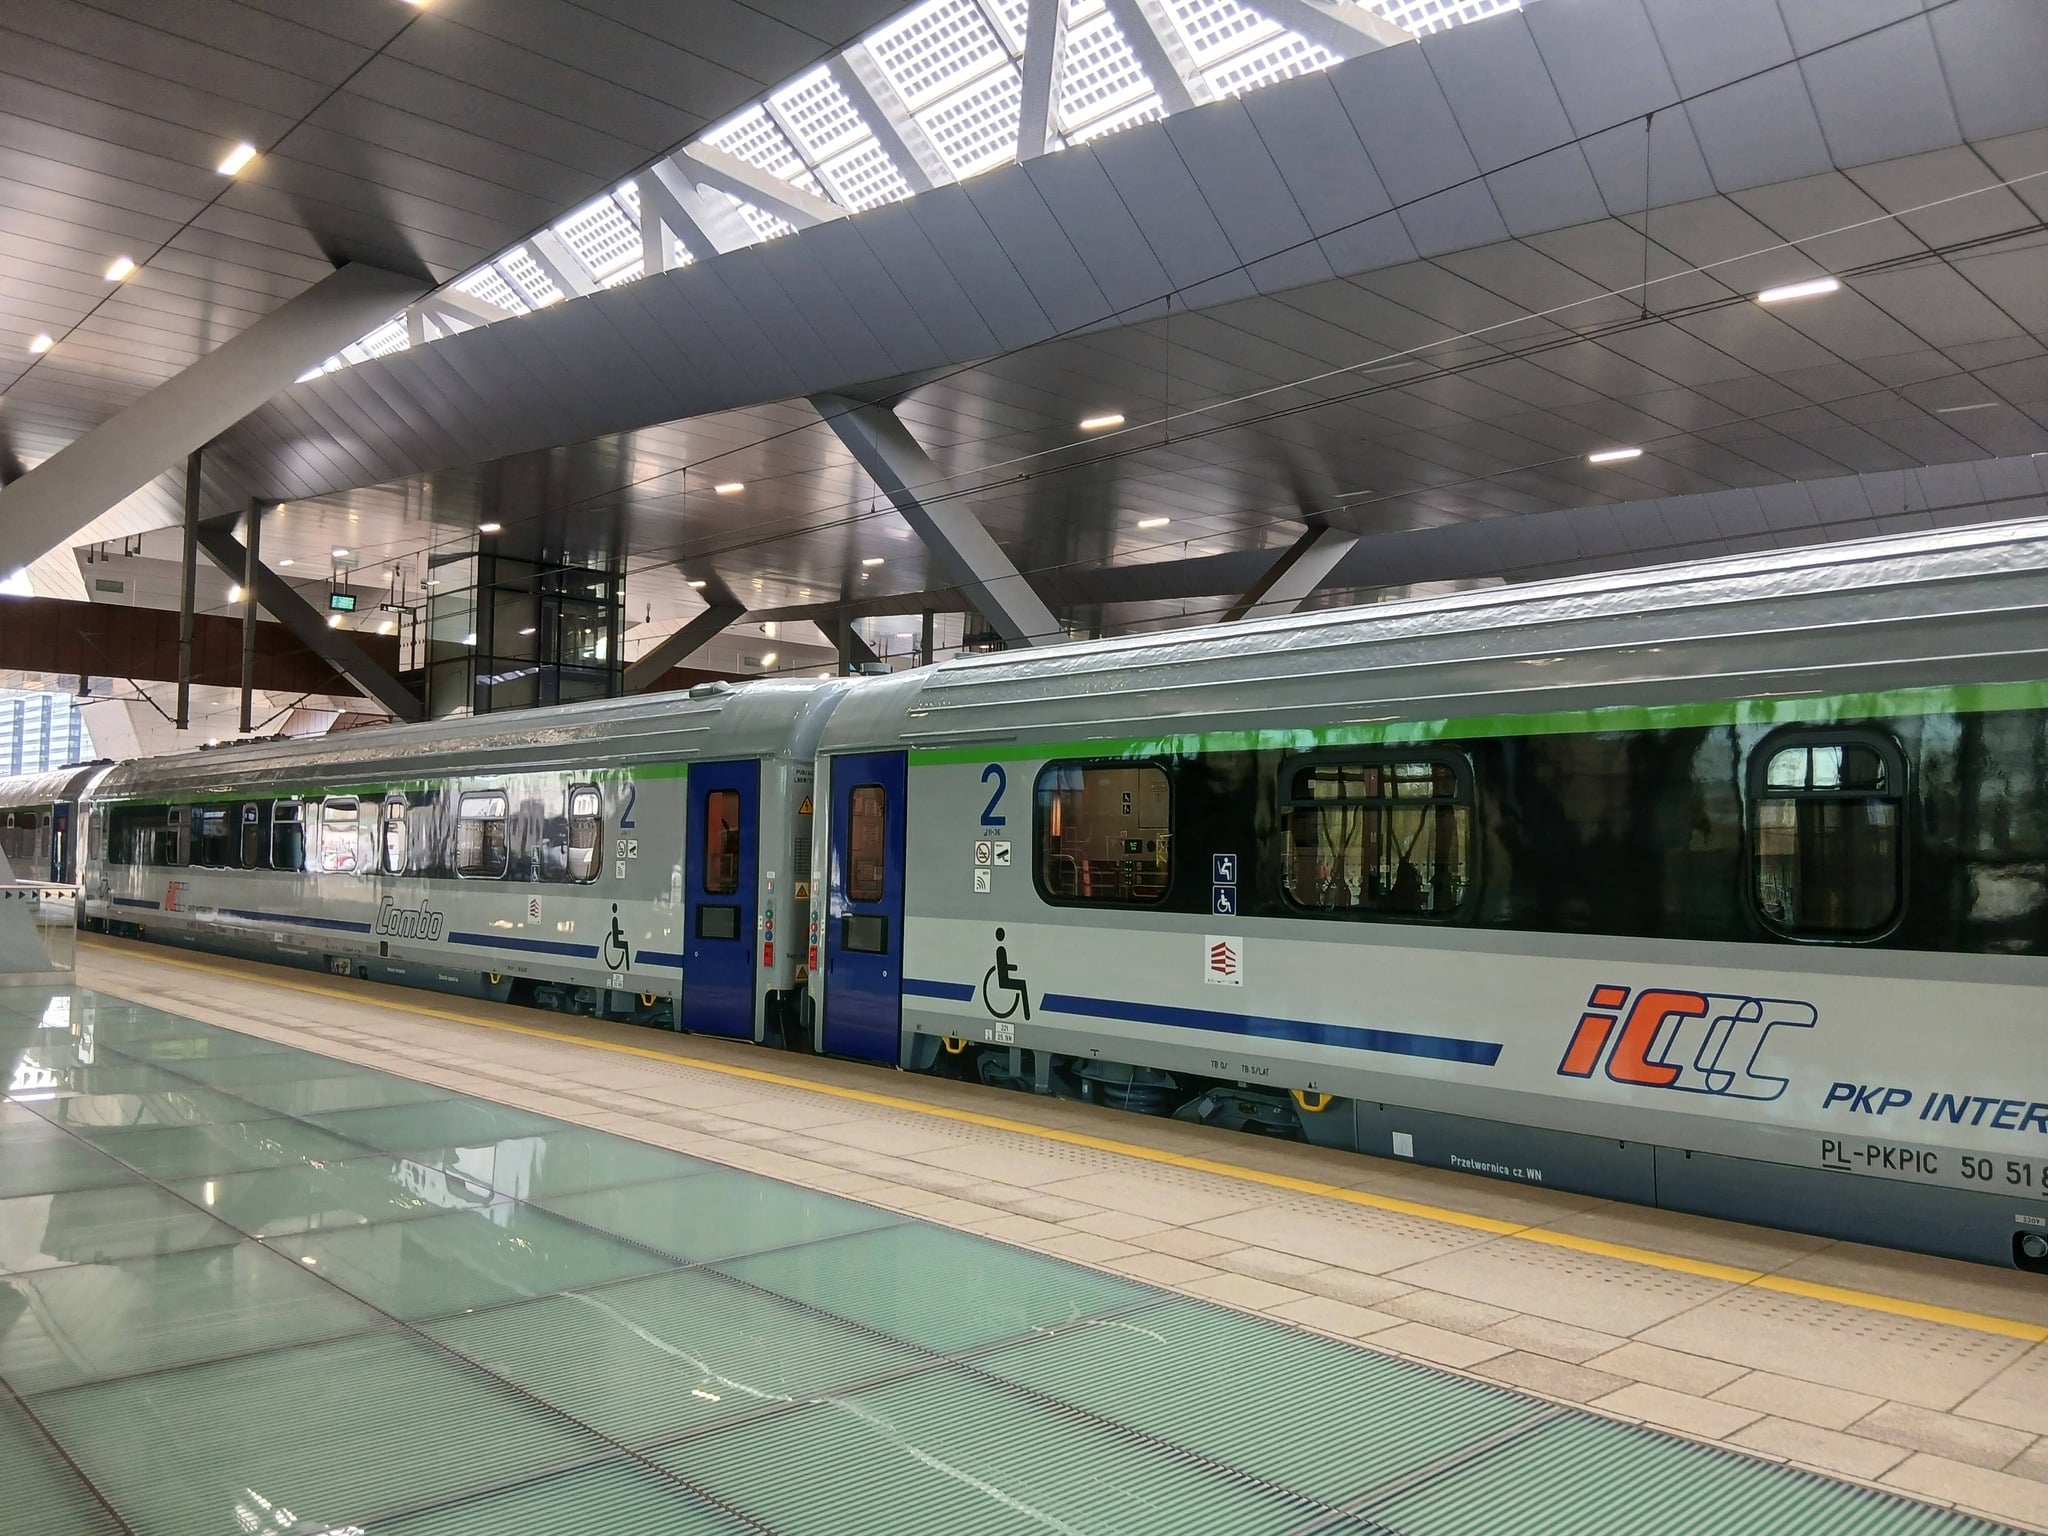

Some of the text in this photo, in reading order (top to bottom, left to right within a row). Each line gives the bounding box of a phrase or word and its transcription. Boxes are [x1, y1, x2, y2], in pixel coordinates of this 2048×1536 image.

[619, 781, 636, 829] 2
[980, 762, 1007, 826] 2
[376, 896, 443, 941] Combo
[1822, 1082, 2048, 1134] PKP INTER
[1526, 1167, 1542, 1181] WN
[1822, 1139, 1938, 1174] PL-PKPIC
[1961, 1156, 1993, 1181] 50
[2006, 1161, 2031, 1187] 51
